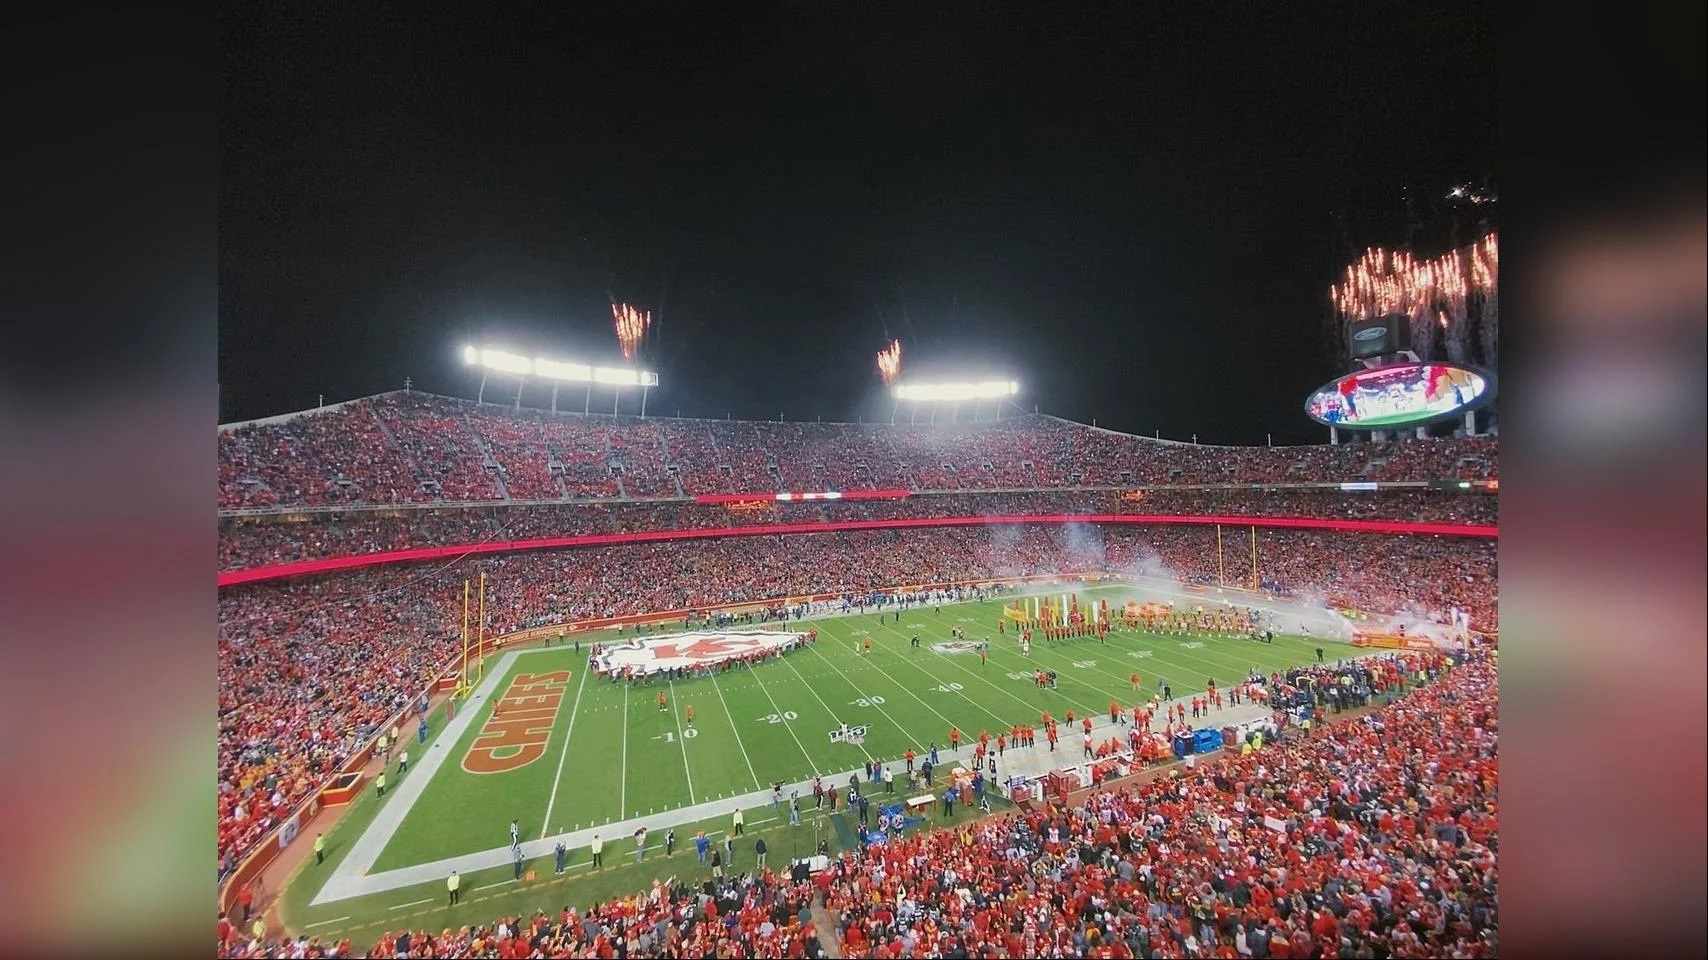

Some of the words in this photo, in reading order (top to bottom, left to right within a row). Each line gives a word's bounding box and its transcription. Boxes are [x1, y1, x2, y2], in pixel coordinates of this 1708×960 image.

[938, 682, 964, 693] 40
[856, 695, 886, 707] 30
[461, 670, 572, 775] CHIEFS
[766, 711, 798, 724] 20
[663, 728, 698, 743] 10
